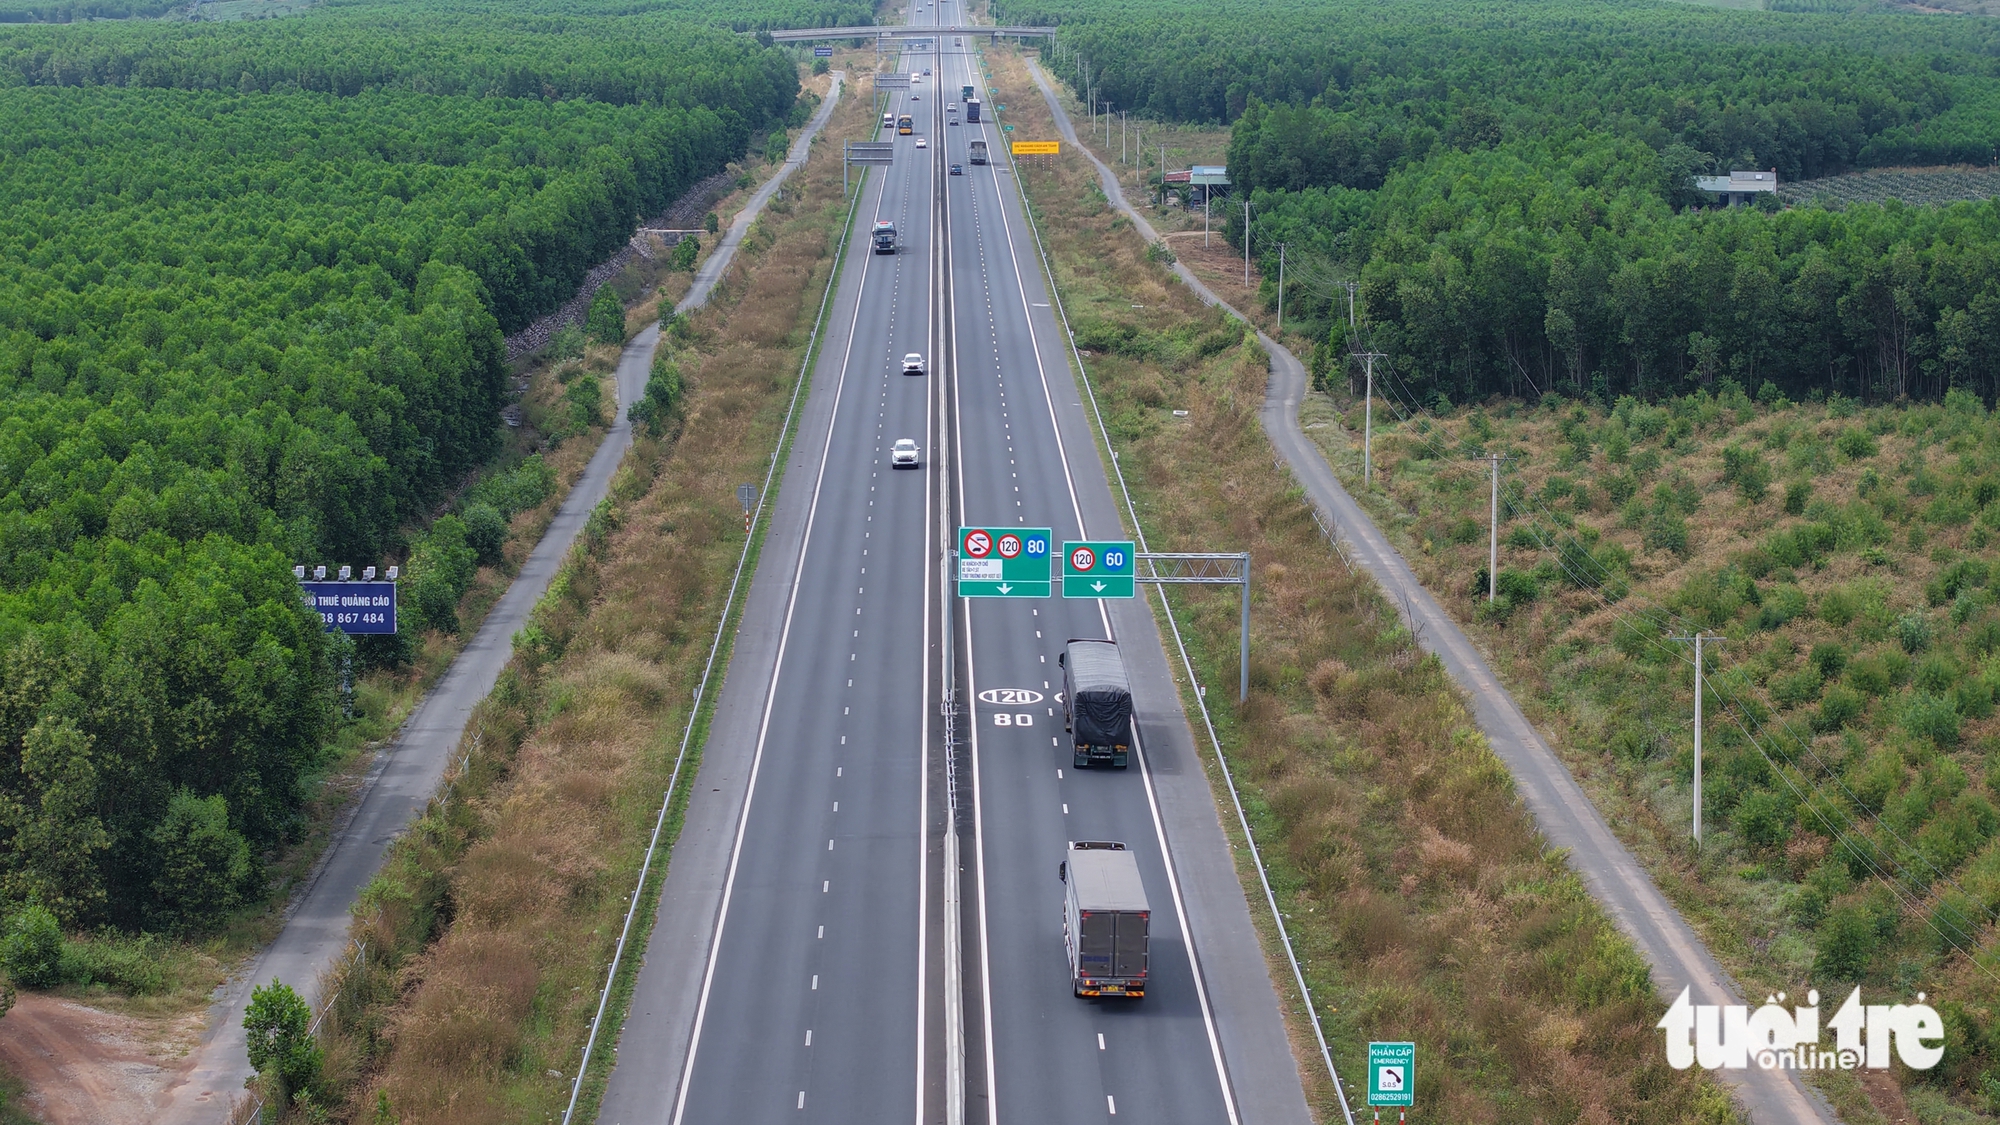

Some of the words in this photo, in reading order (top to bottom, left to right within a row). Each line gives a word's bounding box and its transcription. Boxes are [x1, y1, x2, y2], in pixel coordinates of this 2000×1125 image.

[1001, 541, 1018, 553] 120
[1027, 539, 1045, 554] 80
[1075, 553, 1092, 565] 120
[1105, 552, 1123, 566] 60
[318, 594, 339, 606] THUÊ
[341, 593, 370, 607] QUẢNG
[372, 594, 390, 606] CÁO
[337, 612, 359, 623] 867
[362, 612, 385, 623] 484
[988, 691, 1030, 703] 120
[994, 713, 1033, 726] 80
[1371, 1045, 1395, 1056] KHẨN
[1396, 1046, 1412, 1056] CẤP
